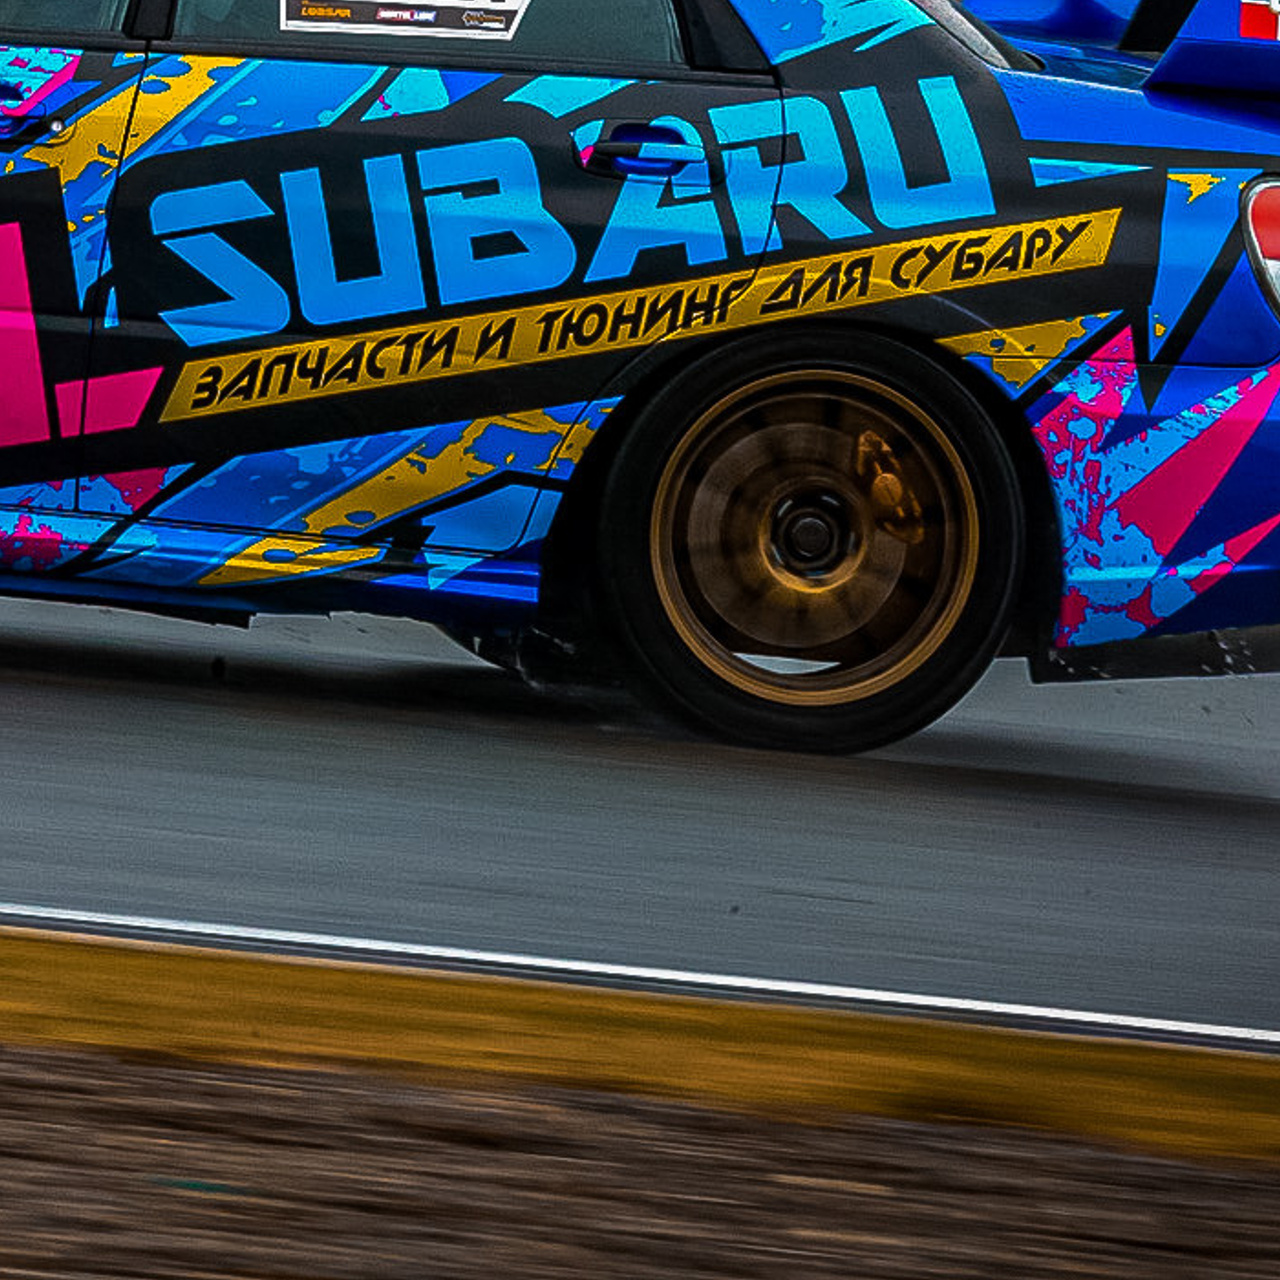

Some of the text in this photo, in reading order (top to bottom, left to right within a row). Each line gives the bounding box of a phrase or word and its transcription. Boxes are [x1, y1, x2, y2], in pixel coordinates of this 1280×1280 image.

[150, 77, 996, 347] SUBARU
[190, 219, 1093, 410] ЗАПЧАСТИ И ТЮНИНГ ДЛЯ СУБАРУ
